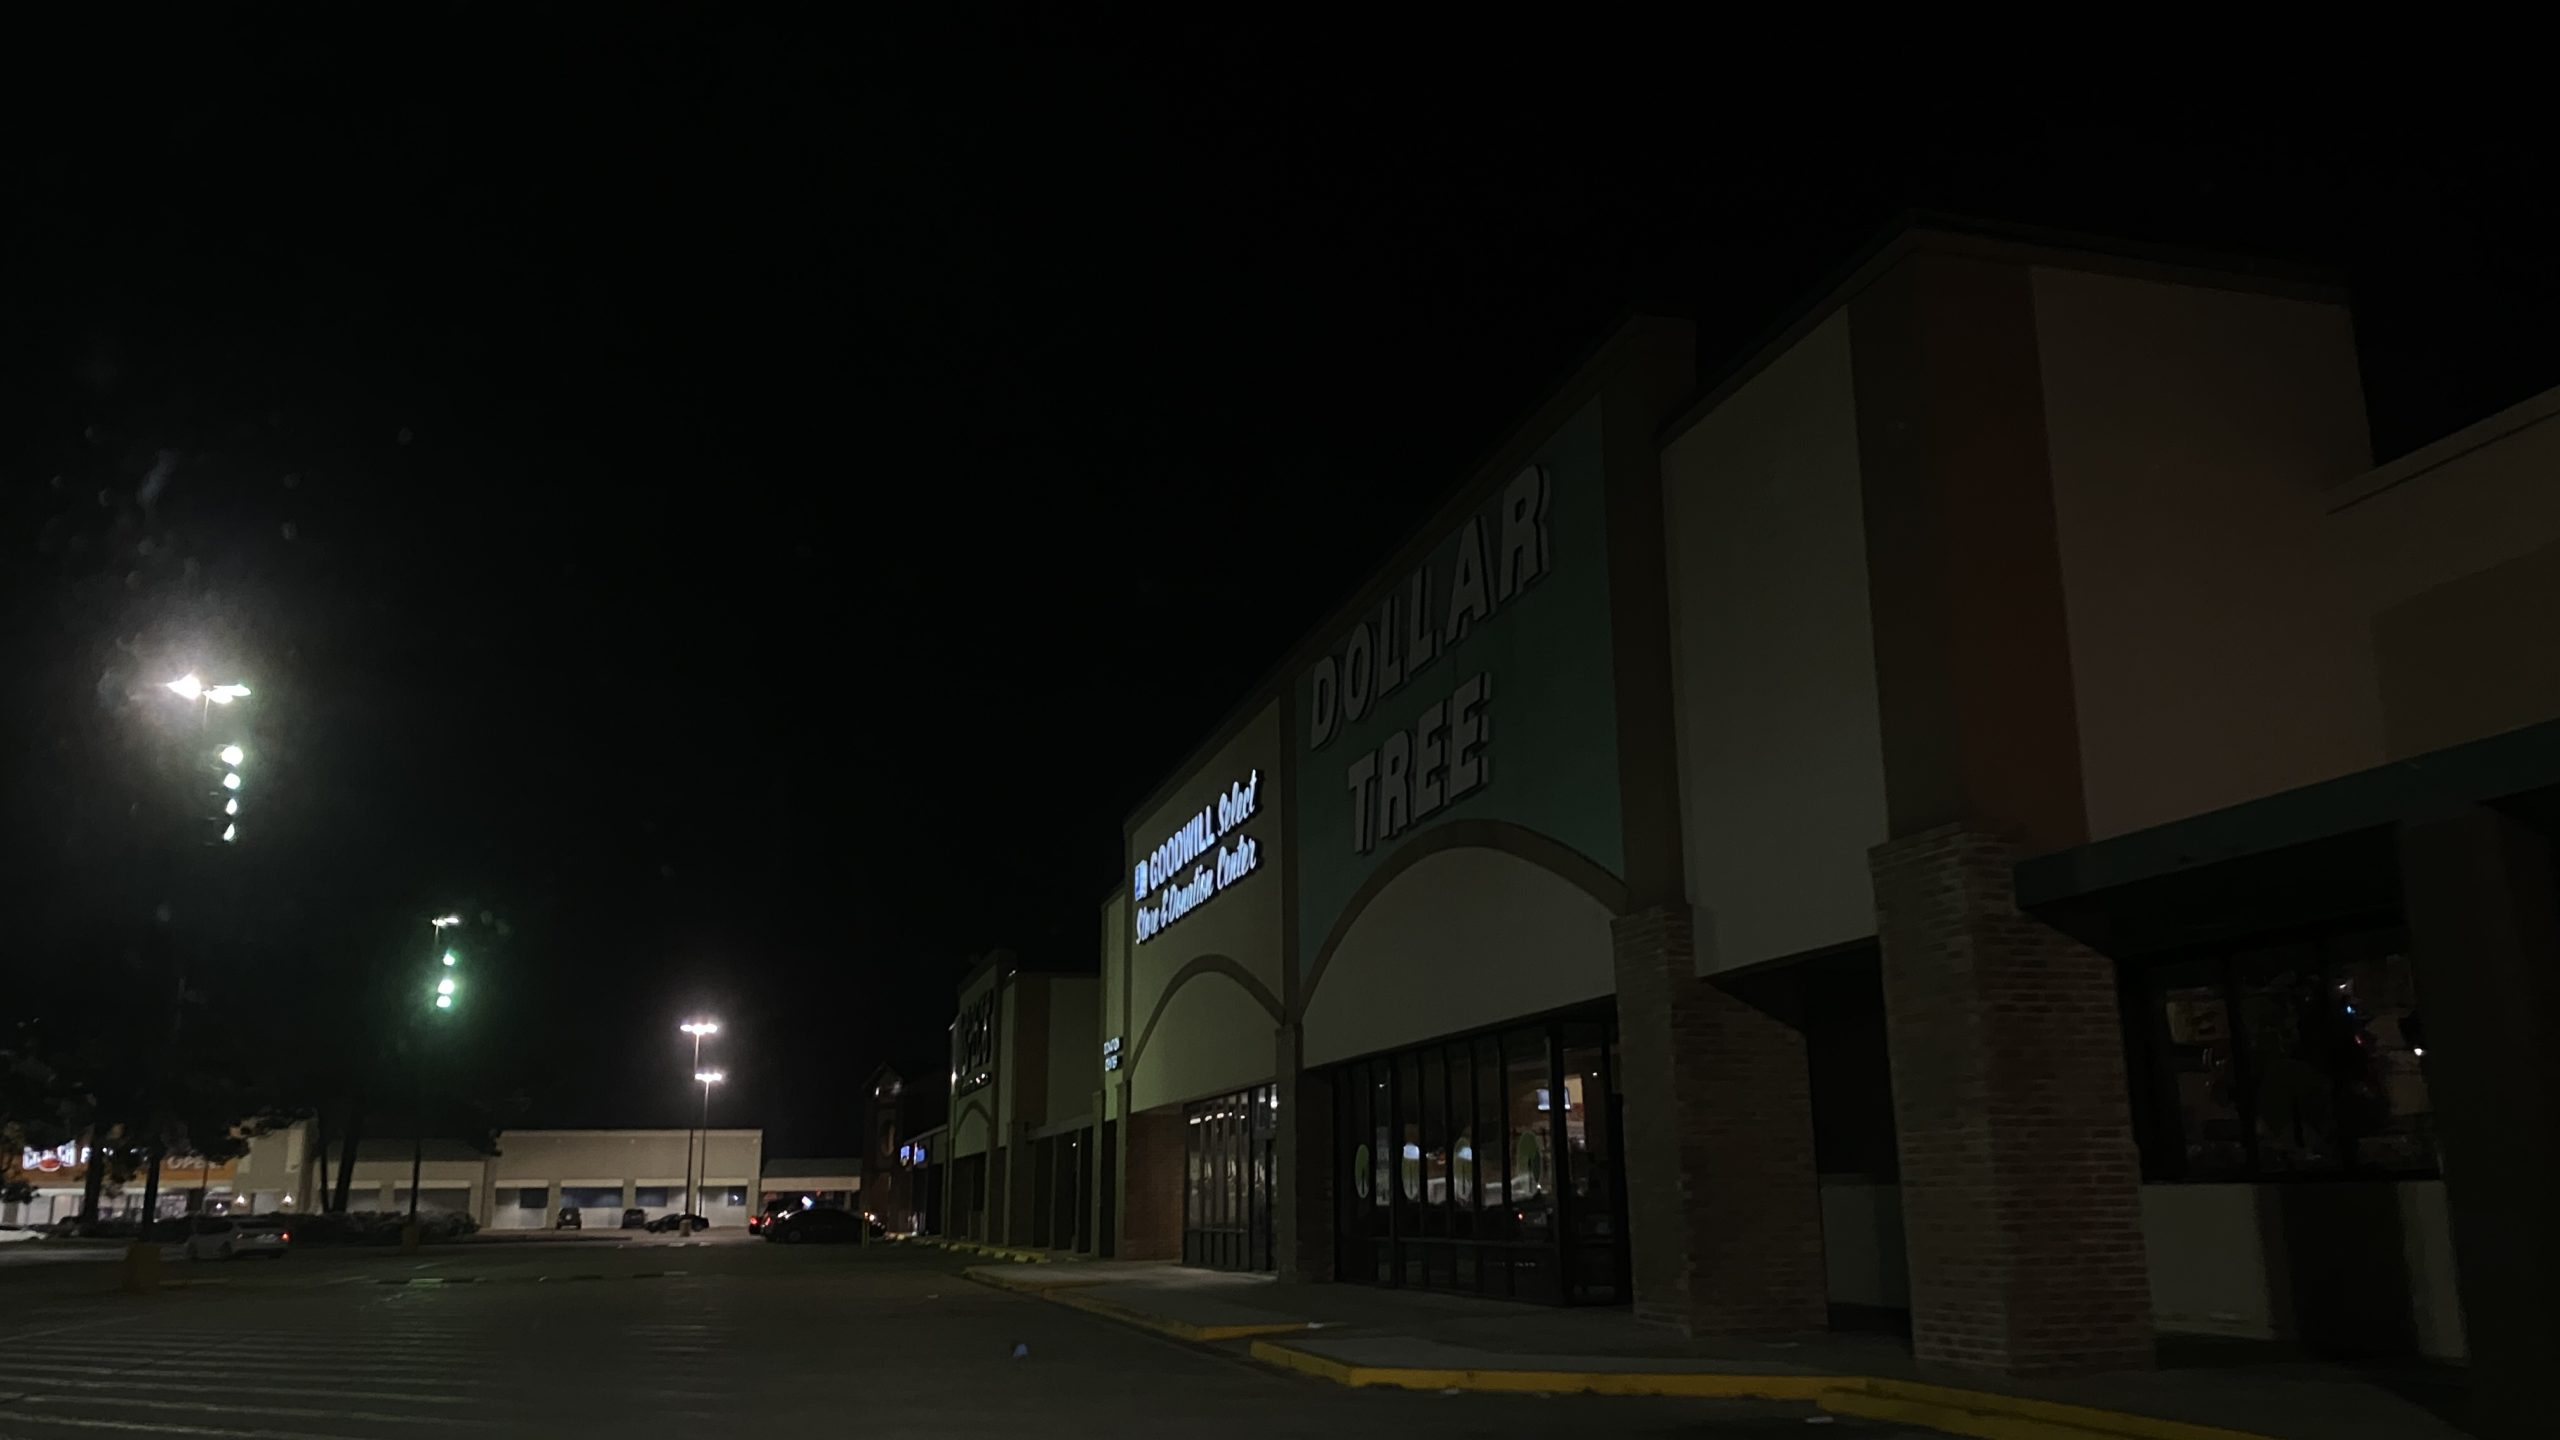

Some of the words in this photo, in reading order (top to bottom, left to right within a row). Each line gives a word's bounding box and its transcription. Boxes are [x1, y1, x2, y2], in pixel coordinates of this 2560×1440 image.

[1311, 464, 1551, 751] DOLLAR
[1149, 805, 1216, 890] GOODWILL
[1217, 769, 1259, 837] Select
[1348, 672, 1491, 854] TREE
[1136, 906, 1160, 944] Store
[1169, 864, 1215, 923] Donation
[1217, 834, 1257, 890] Center
